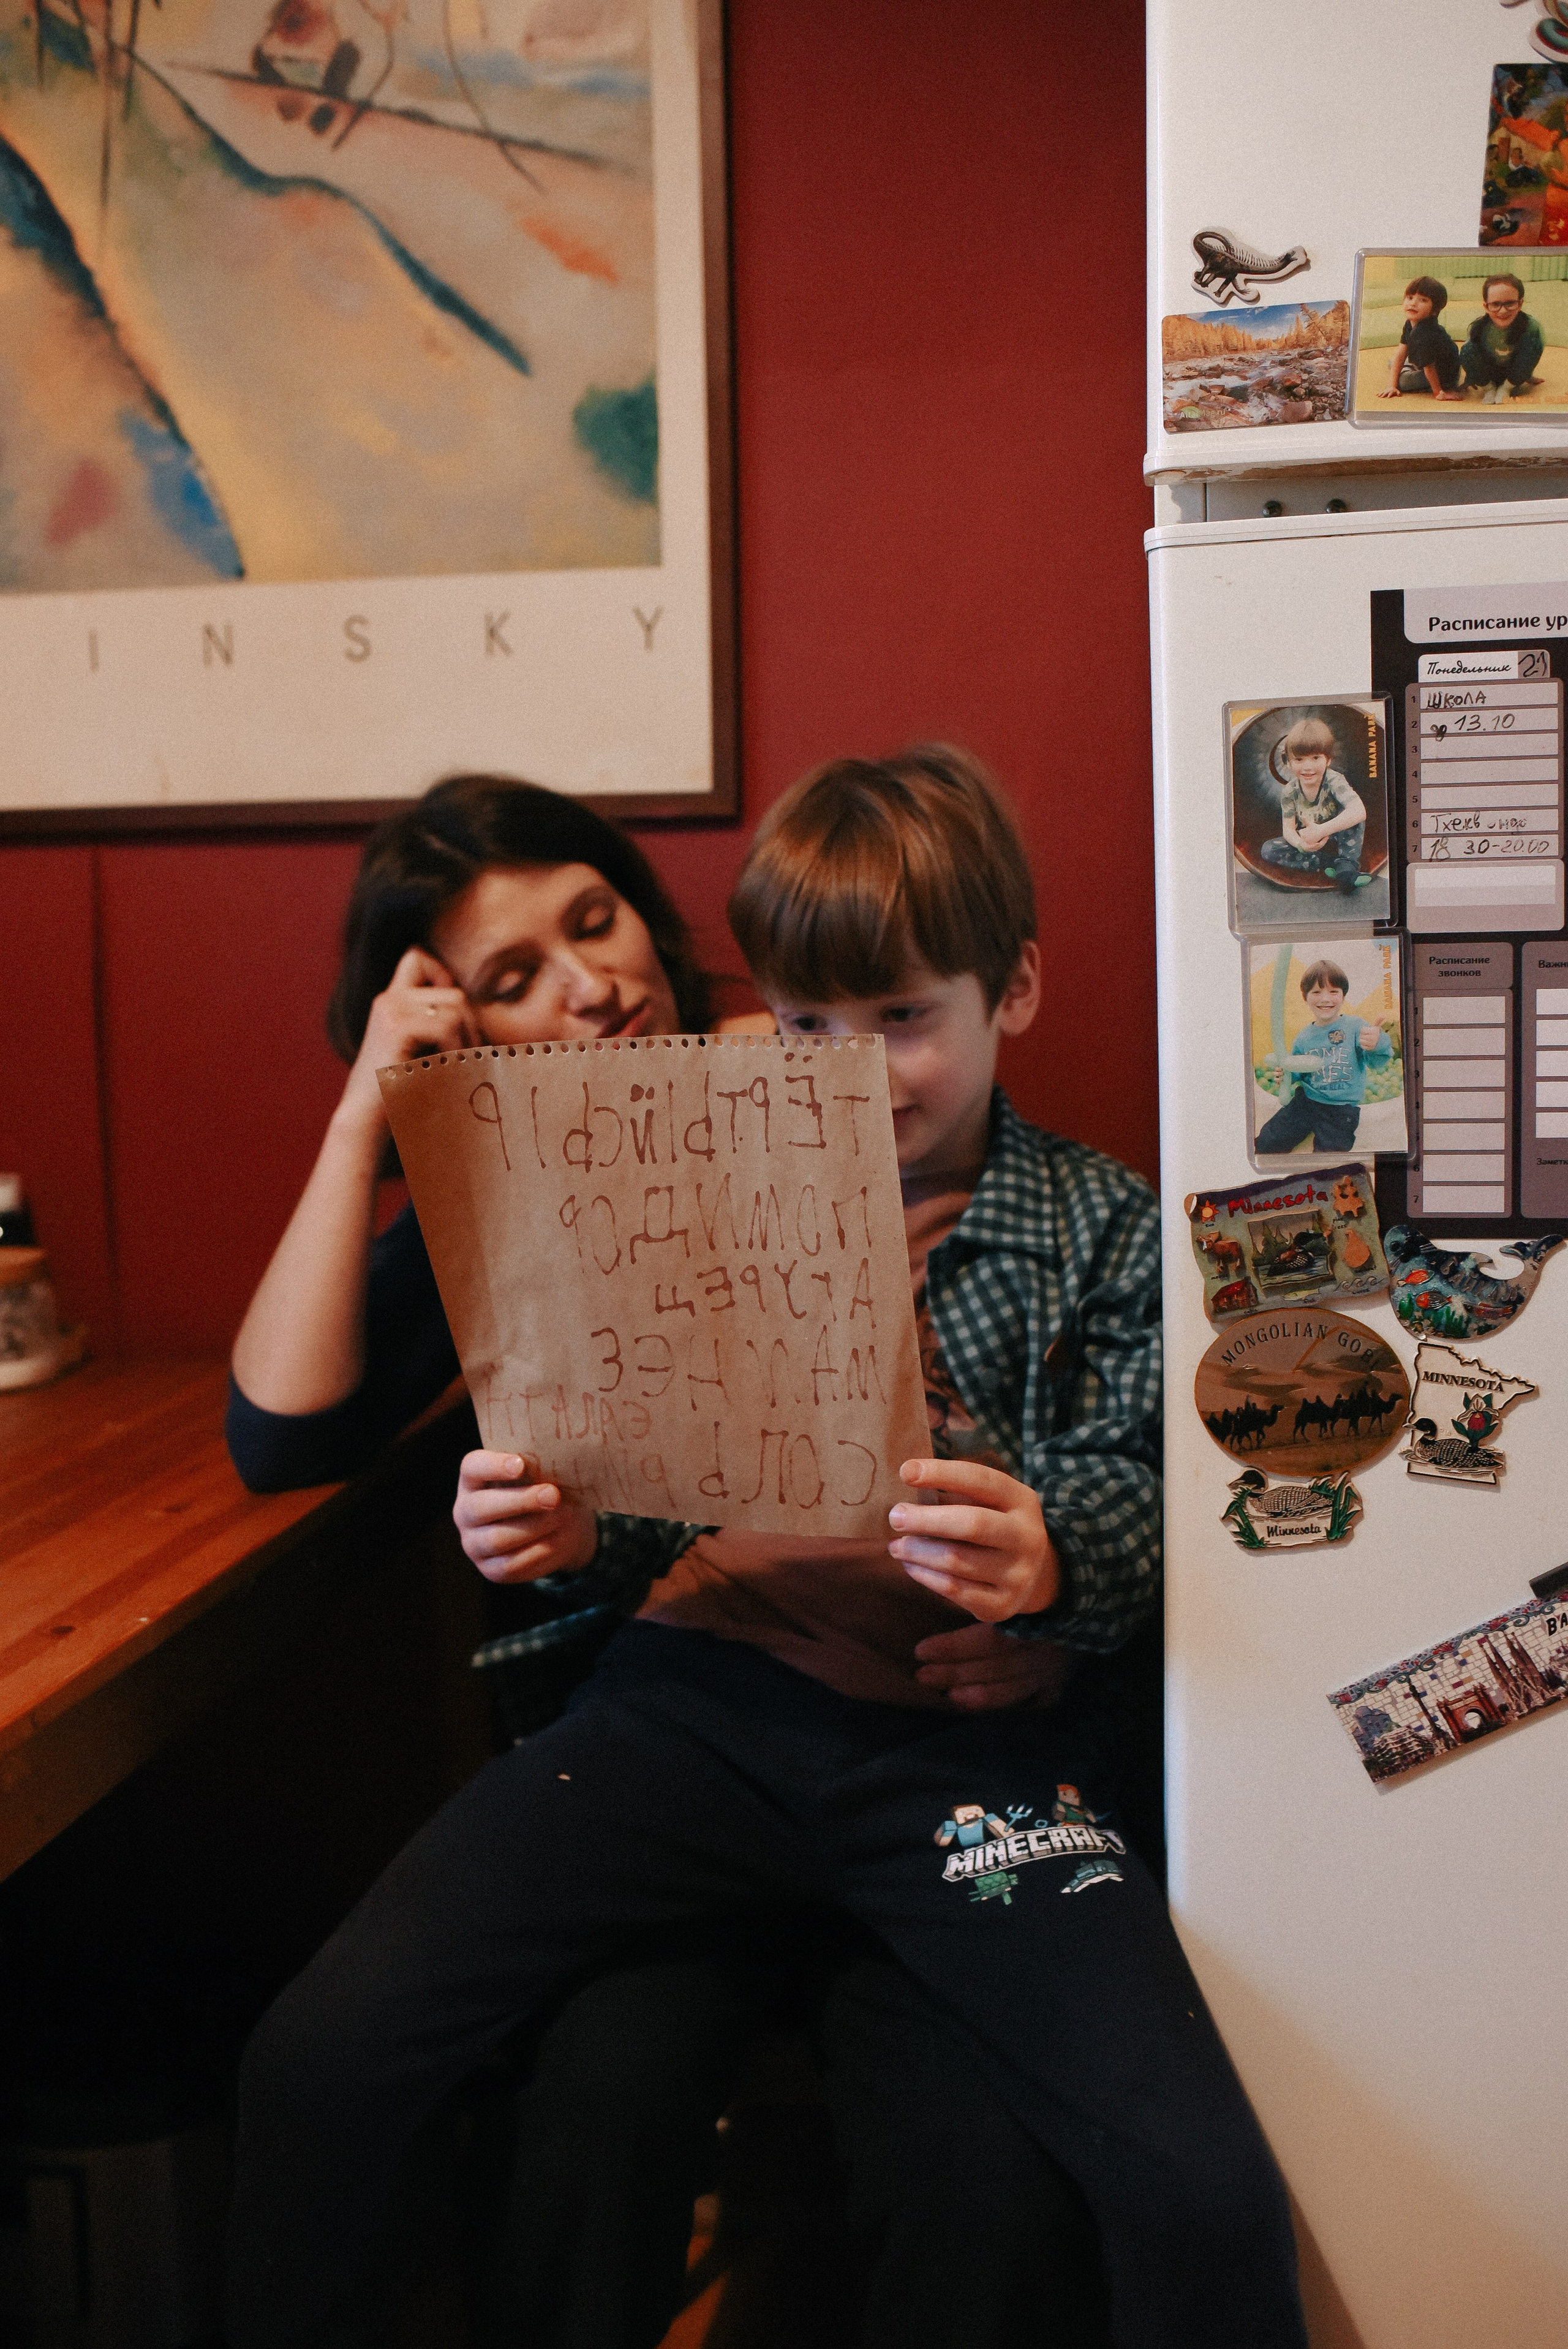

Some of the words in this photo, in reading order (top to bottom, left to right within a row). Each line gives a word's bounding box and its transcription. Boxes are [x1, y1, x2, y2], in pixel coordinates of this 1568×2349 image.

[1428, 616, 1540, 632] Расписание
[1545, 615, 1568, 631] ур
[1427, 660, 1512, 675] Понедельник
[1427, 690, 1487, 709] ШКОЛА
[1455, 713, 1515, 732] 13.10
[1368, 741, 1377, 778] BANANA
[1412, 820, 1419, 828] 6
[1428, 956, 1491, 965] Расписание
[1538, 959, 1568, 968] Важн
[1414, 1164, 1420, 1172] 6
[1227, 1184, 1329, 1218] Minnesota
[1413, 1195, 1419, 1204] 7
[1221, 1322, 1329, 1366] MONGOLIAN
[1422, 1371, 1504, 1392] MINNESOTA
[1266, 1523, 1322, 1538] Minnesota
[1545, 1612, 1568, 1637] BA
[943, 1826, 1126, 1882] MINECRAFT
